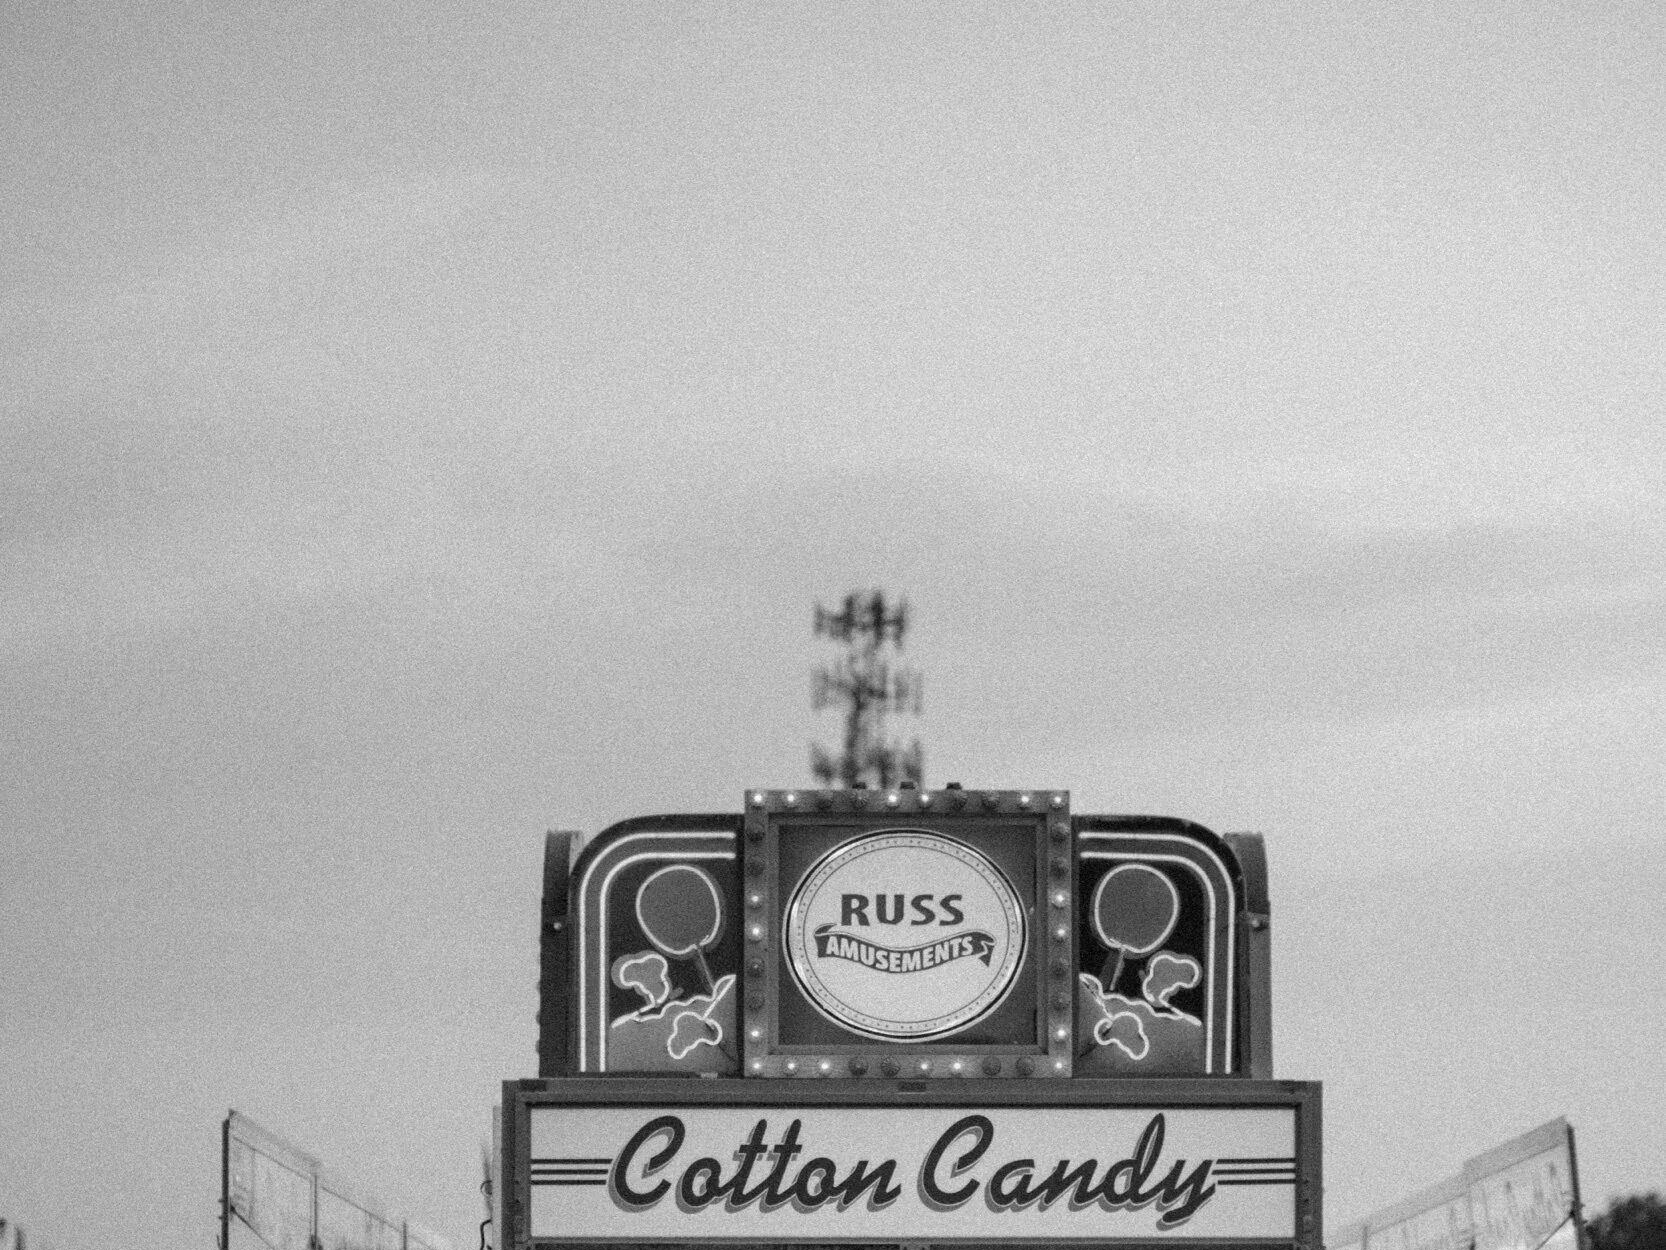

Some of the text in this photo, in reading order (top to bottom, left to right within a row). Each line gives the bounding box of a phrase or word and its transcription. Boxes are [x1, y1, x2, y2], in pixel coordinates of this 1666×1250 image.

[841, 894, 964, 926] RUSS
[826, 936, 973, 973] AMUSEMENTS
[608, 1112, 1216, 1231] Cotton Candy
